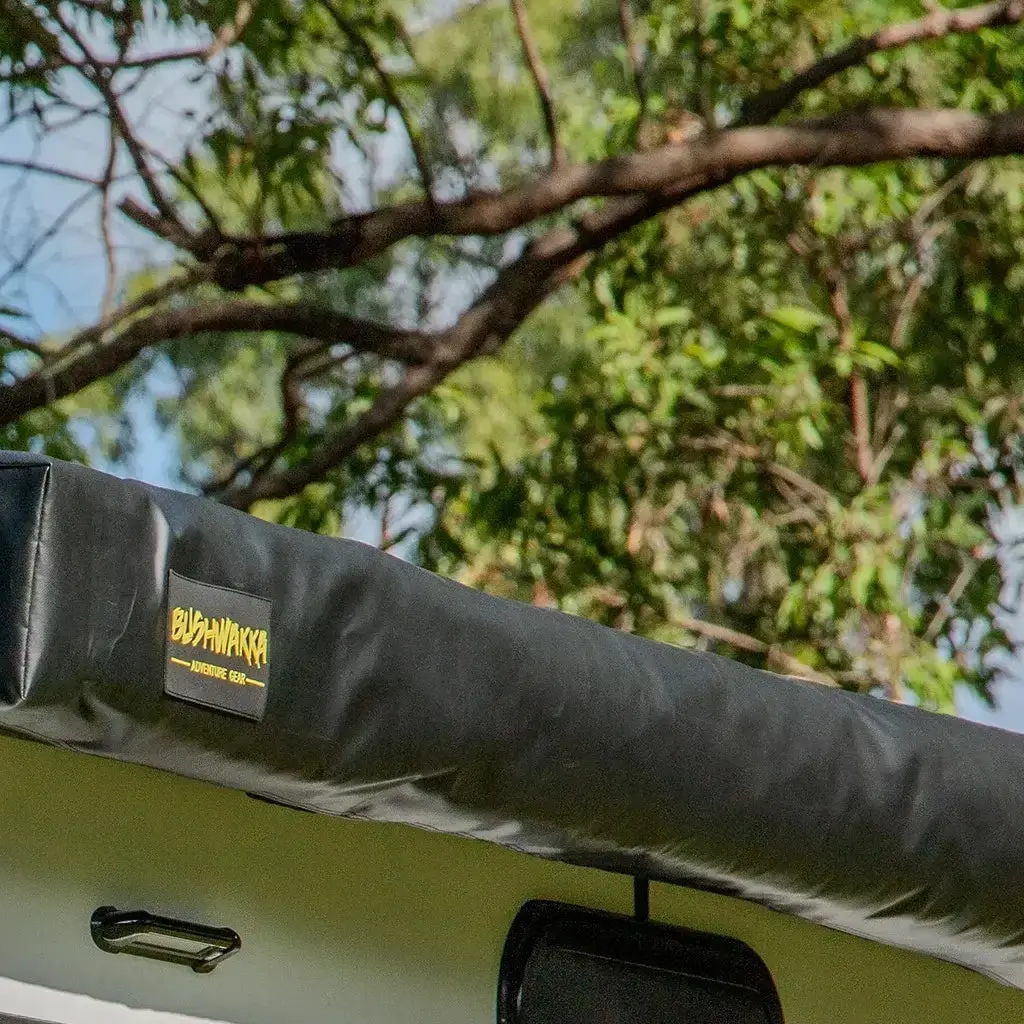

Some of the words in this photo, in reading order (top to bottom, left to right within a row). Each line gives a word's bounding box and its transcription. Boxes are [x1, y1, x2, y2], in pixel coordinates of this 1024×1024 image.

[171, 607, 268, 669] BUSHWAKKA
[190, 660, 228, 681] ADVENTURE
[228, 670, 247, 685] GEAR
